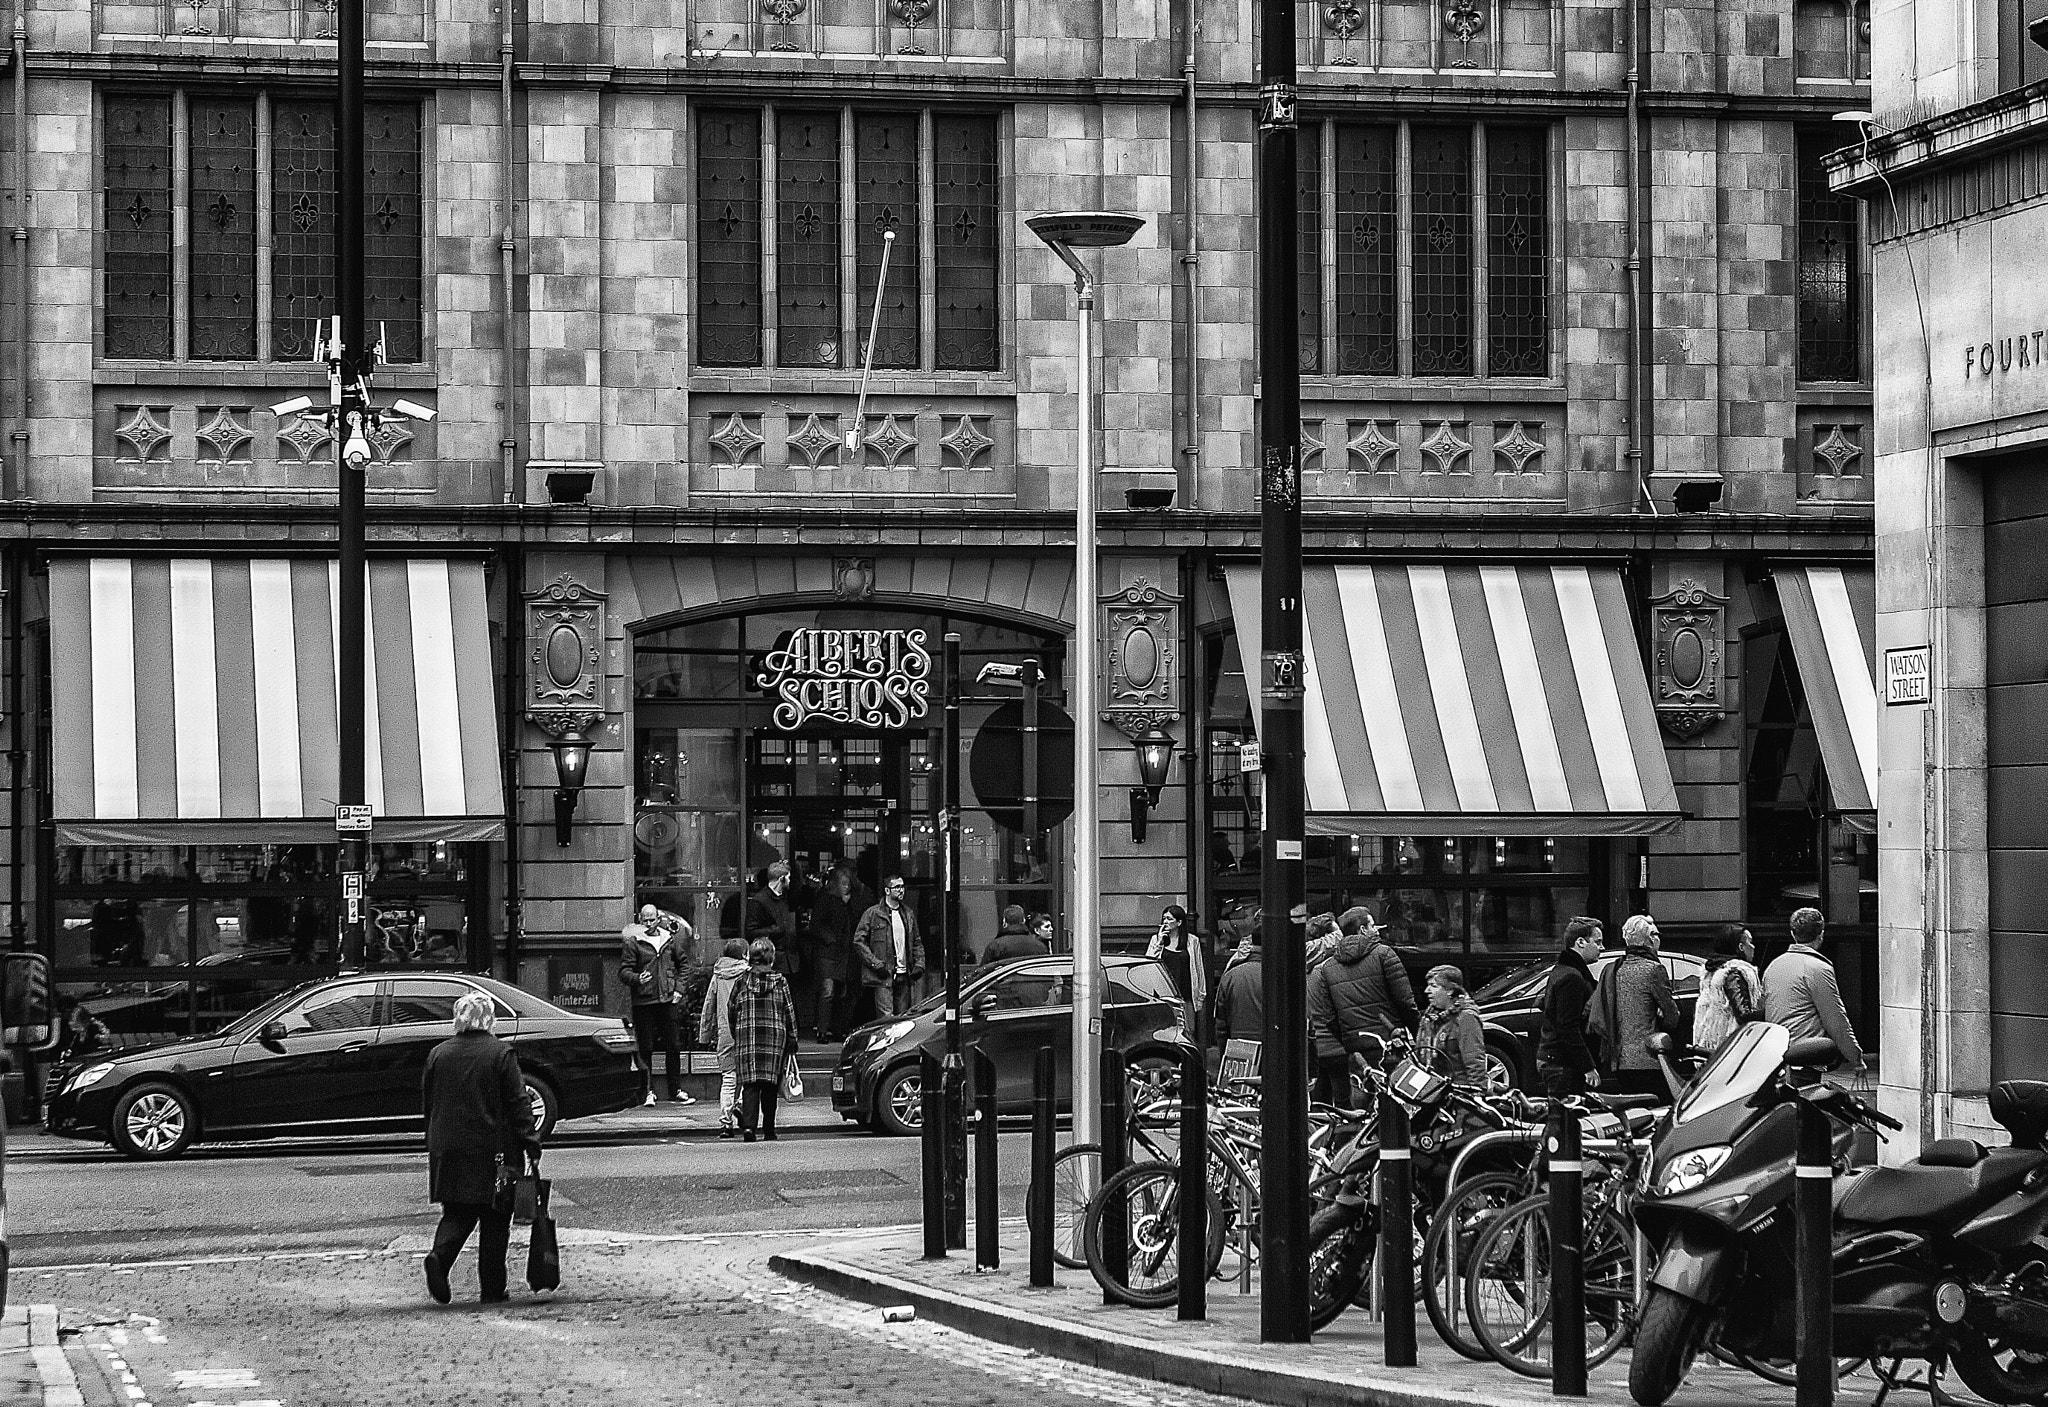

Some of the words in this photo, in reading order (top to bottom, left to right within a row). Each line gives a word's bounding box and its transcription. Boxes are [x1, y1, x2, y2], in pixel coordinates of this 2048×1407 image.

[756, 627, 932, 688] ALBERTS
[1890, 653, 1927, 675] WATSON
[1892, 677, 1925, 699] STREET
[773, 674, 930, 731] SCHLOSS
[340, 808, 349, 819] P
